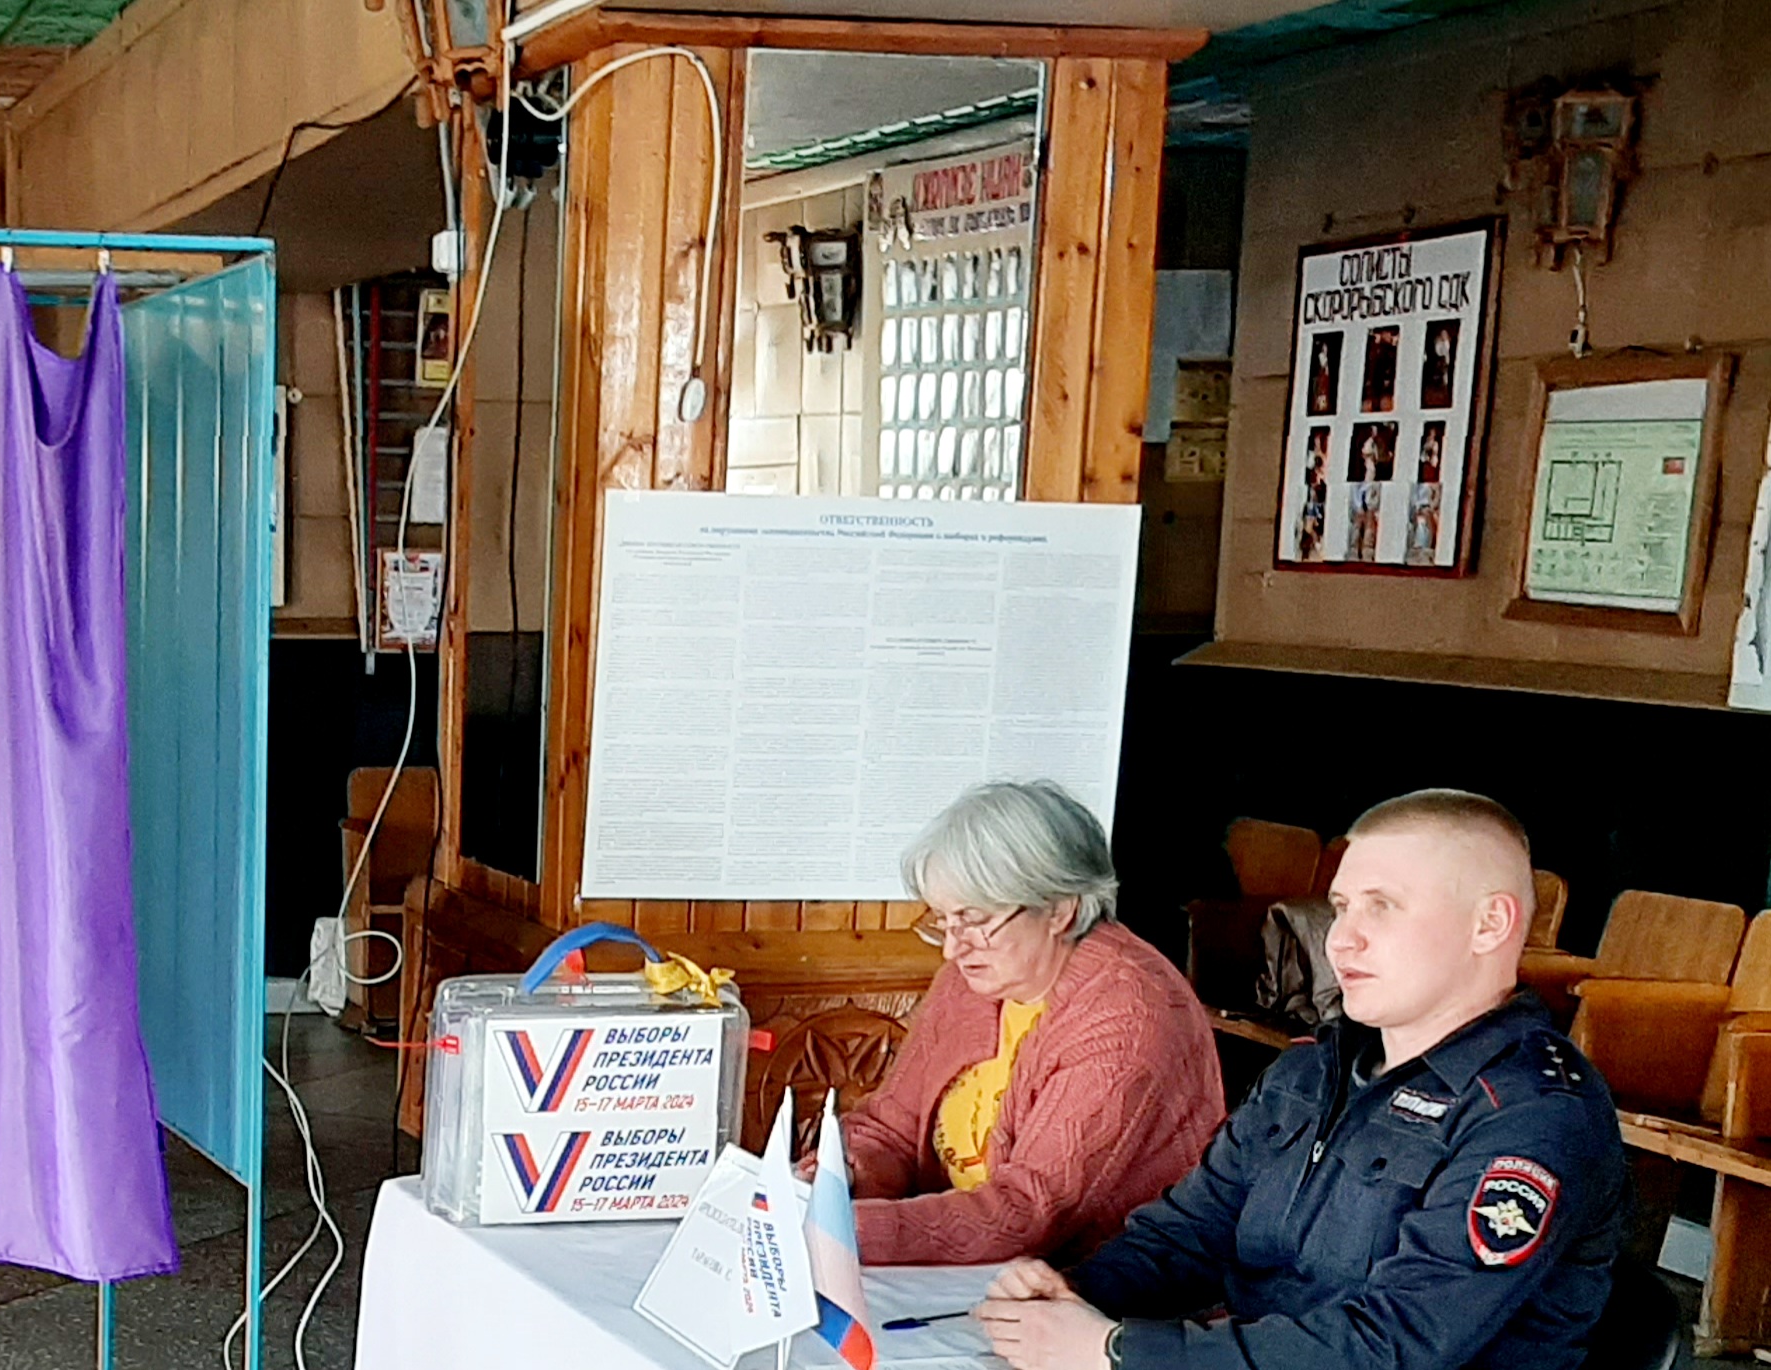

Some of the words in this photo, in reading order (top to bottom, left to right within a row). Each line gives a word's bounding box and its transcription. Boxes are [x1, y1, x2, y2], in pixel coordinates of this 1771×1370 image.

[1340, 245, 1413, 287] СОЛИСТЫ
[1437, 270, 1471, 312] СДК
[819, 514, 934, 527] ОТВЕТСТВЕННОСТЬ
[604, 1025, 691, 1045] ВЫБОРЫ
[593, 1048, 714, 1069] ПРЕЗИДЕНТА
[582, 1073, 661, 1092] РОССИИ
[613, 1095, 660, 1111] МАРТА
[662, 1094, 694, 1110] 2024
[600, 1127, 686, 1147] ВЫБОРЫ
[589, 1149, 710, 1170] ПРЕЗИДЕНТА
[578, 1173, 657, 1192] РОССИИ
[609, 1195, 656, 1210] МАРТА
[657, 1194, 690, 1209] 2024
[1482, 1179, 1547, 1214] РОССИЯ
[763, 1222, 787, 1292] ВЫБОРЫ
[753, 1219, 782, 1318] ПРЕЗИДЕНТА
